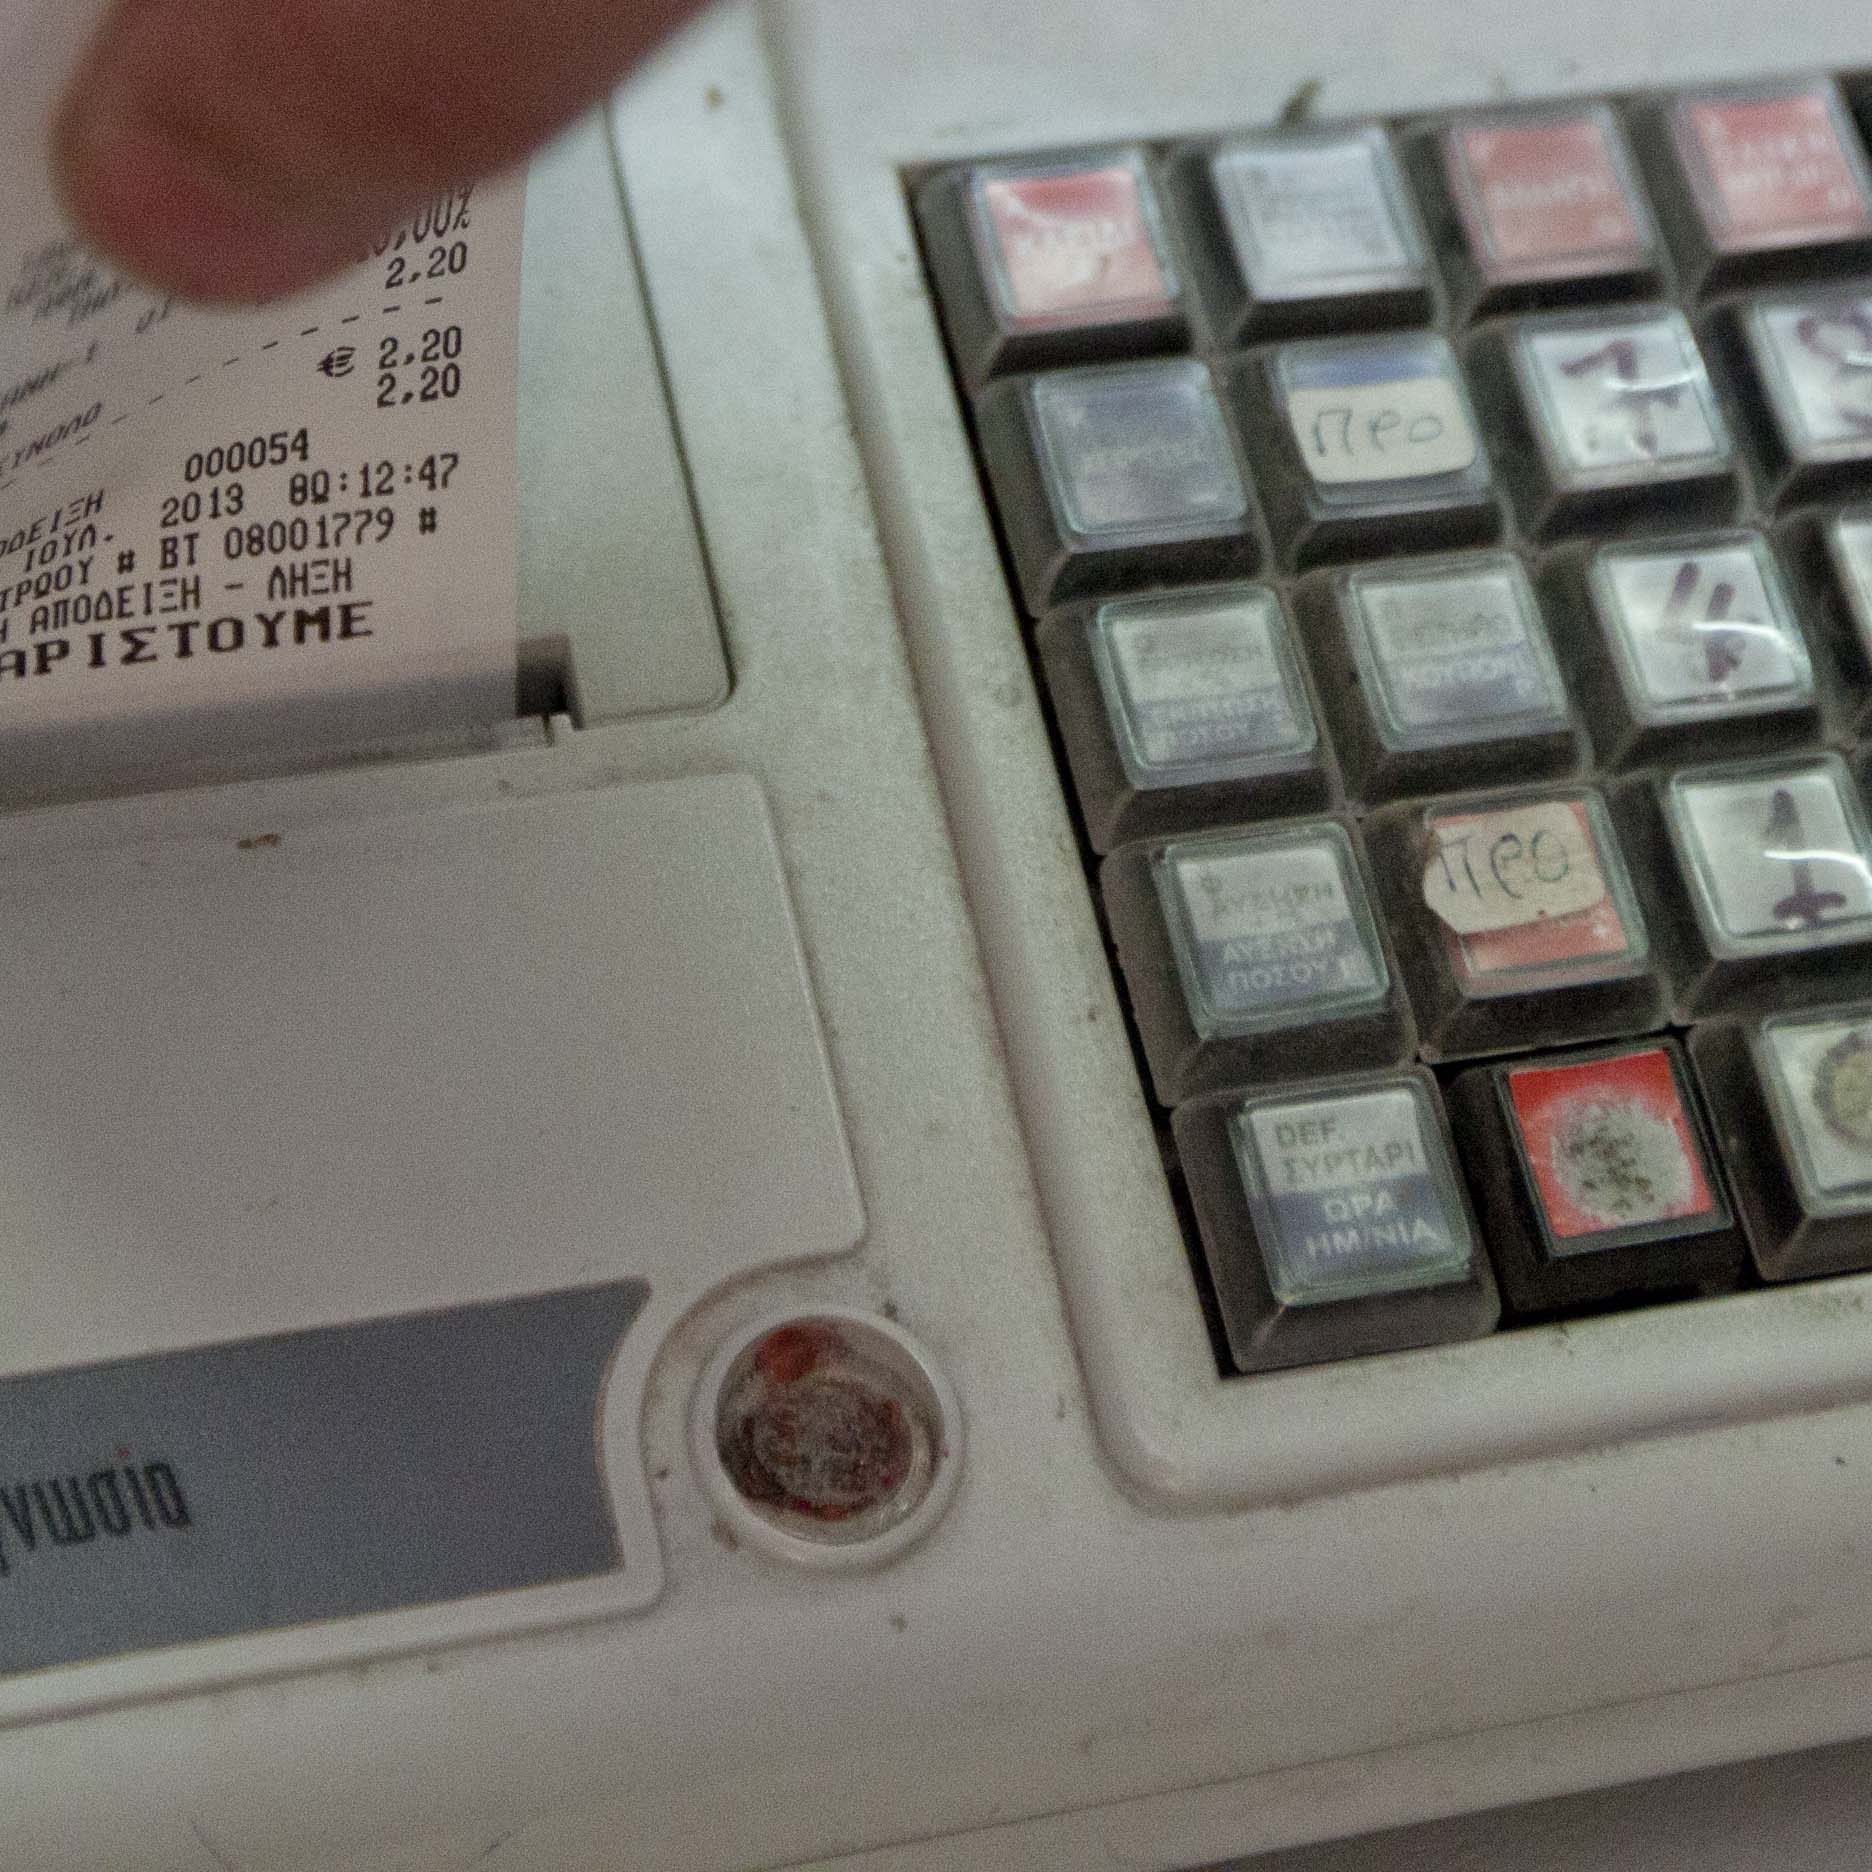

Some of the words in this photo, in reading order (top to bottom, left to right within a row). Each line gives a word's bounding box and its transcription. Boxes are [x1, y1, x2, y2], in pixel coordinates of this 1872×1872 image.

[316, 346, 357, 378] €
[183, 427, 310, 484] 000054
[159, 481, 245, 530] 2013
[223, 505, 395, 561] 08001779
[29, 574, 203, 636] ΑΠΟΔΕΙΞΗ
[266, 557, 353, 602] ΛΗΞΗ
[1322, 1189, 1398, 1226] ΩΡΑ
